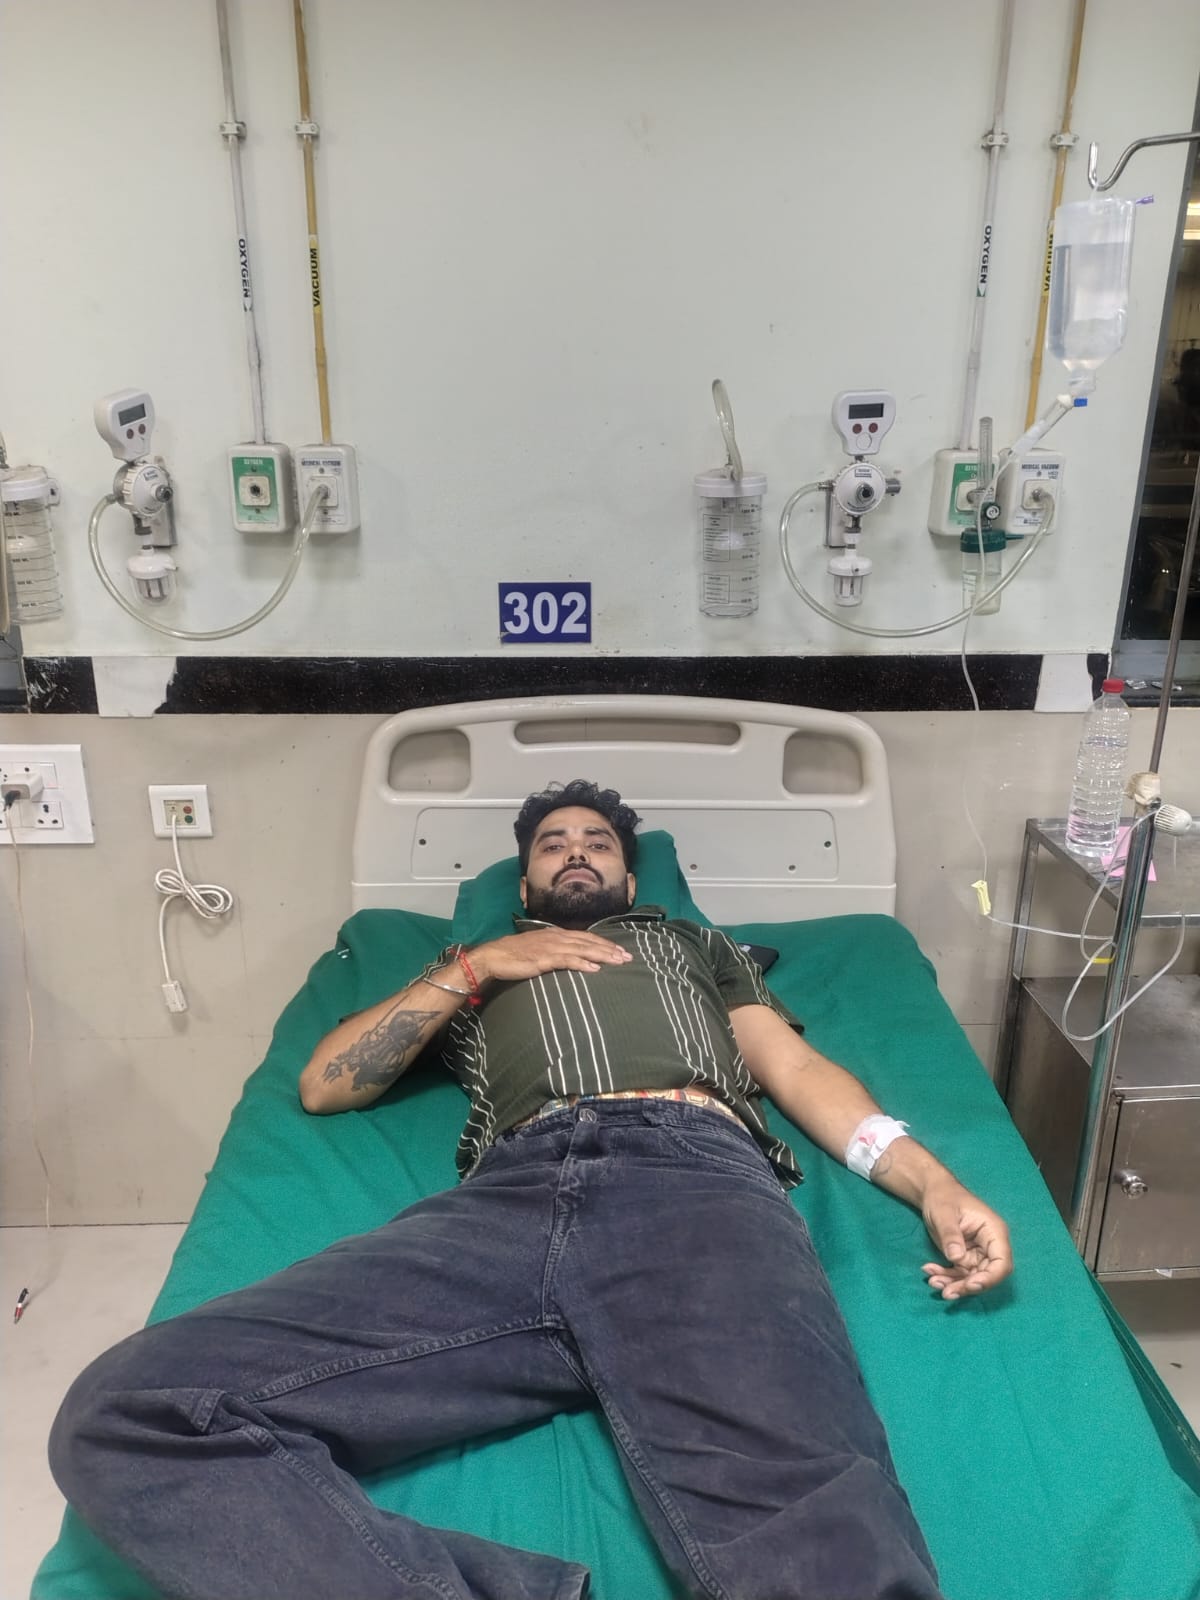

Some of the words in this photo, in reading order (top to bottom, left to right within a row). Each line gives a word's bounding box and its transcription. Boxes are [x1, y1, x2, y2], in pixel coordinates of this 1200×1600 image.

[238, 239, 250, 298] OXYGEN
[309, 248, 321, 307] VACUUM
[980, 225, 992, 284] OXYGEN
[503, 591, 587, 635] 302
